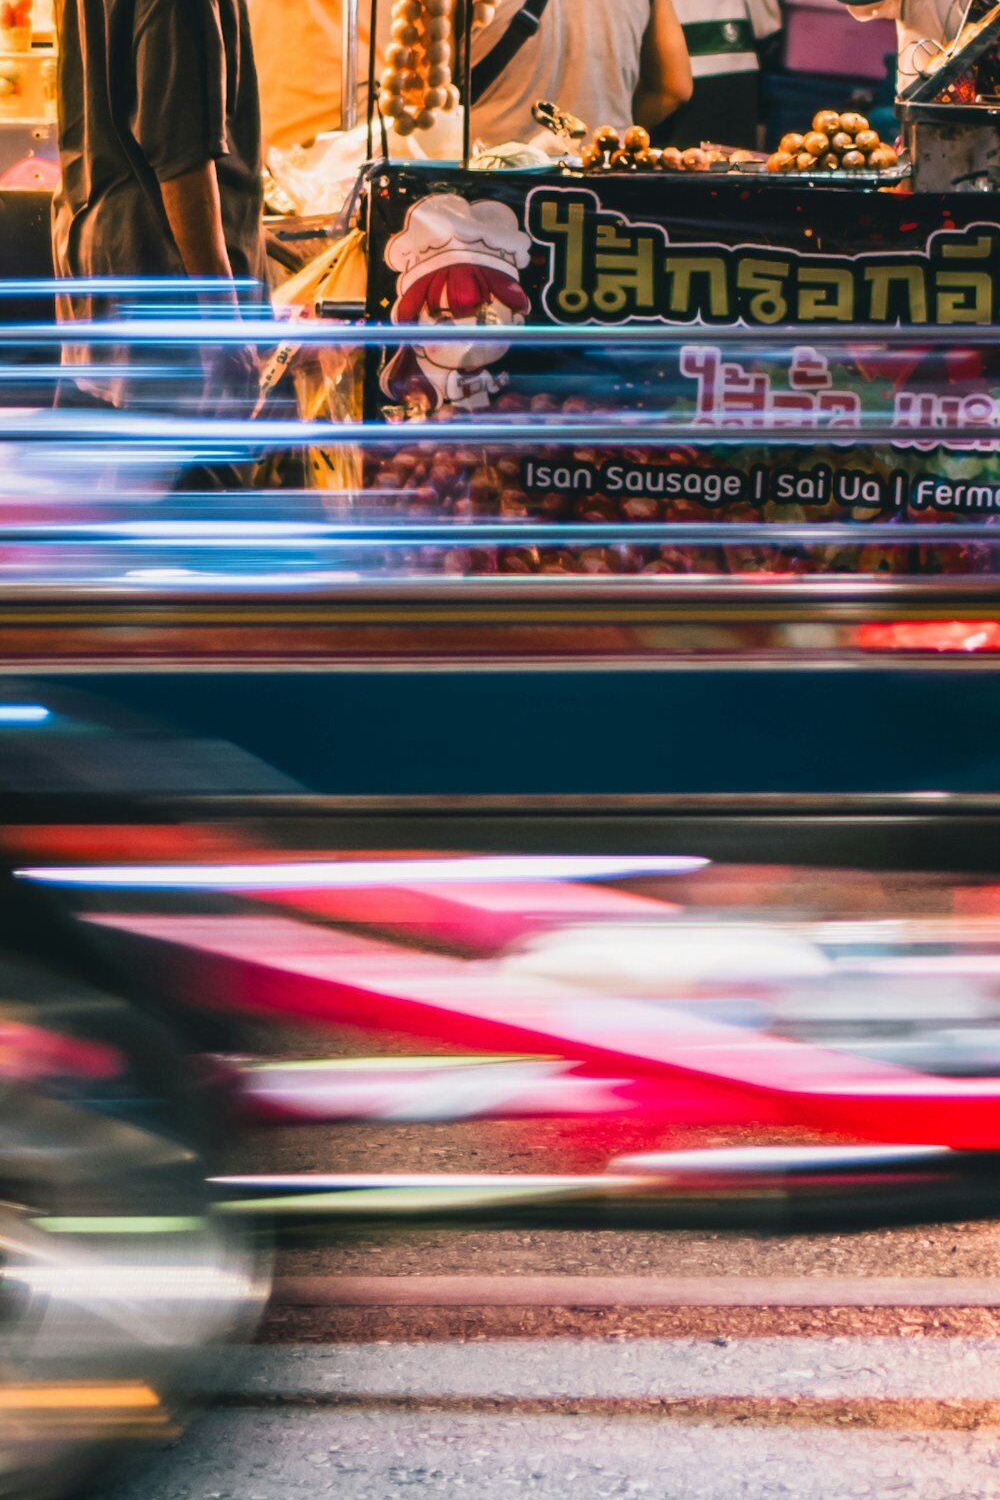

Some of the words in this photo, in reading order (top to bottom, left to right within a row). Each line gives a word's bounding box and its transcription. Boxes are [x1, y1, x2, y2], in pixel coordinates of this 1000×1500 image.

[526, 462, 592, 489] Isan
[606, 466, 742, 501] Sausage
[777, 470, 826, 499] Sai
[839, 476, 880, 501] Ua
